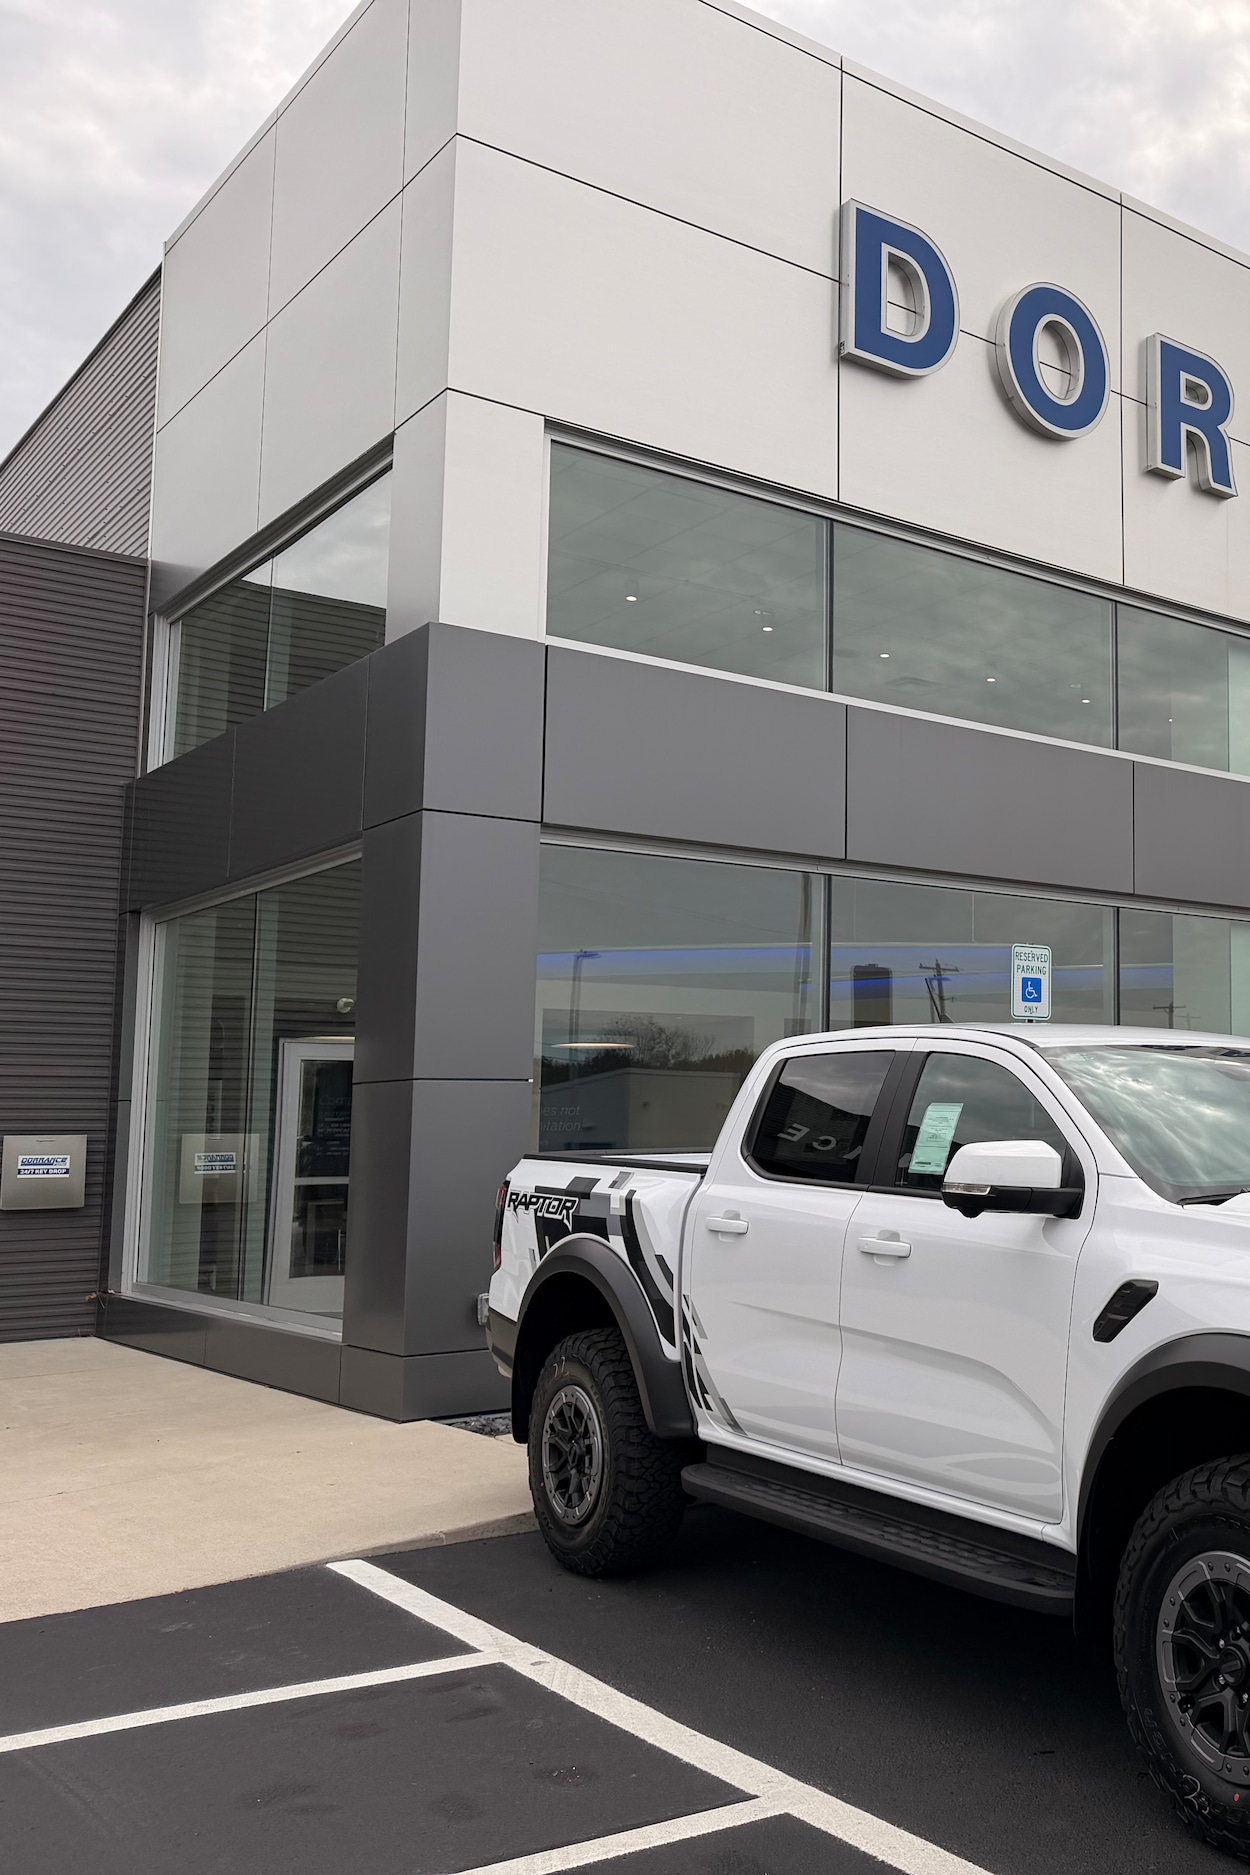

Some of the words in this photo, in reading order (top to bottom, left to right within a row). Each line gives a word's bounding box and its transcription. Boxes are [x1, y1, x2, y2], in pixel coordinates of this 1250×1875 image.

[1015, 951, 1049, 963] RESERVED
[1016, 964, 1047, 975] PARKING
[1023, 1005, 1039, 1014] ONLY
[506, 1190, 578, 1231] RAPTOR
